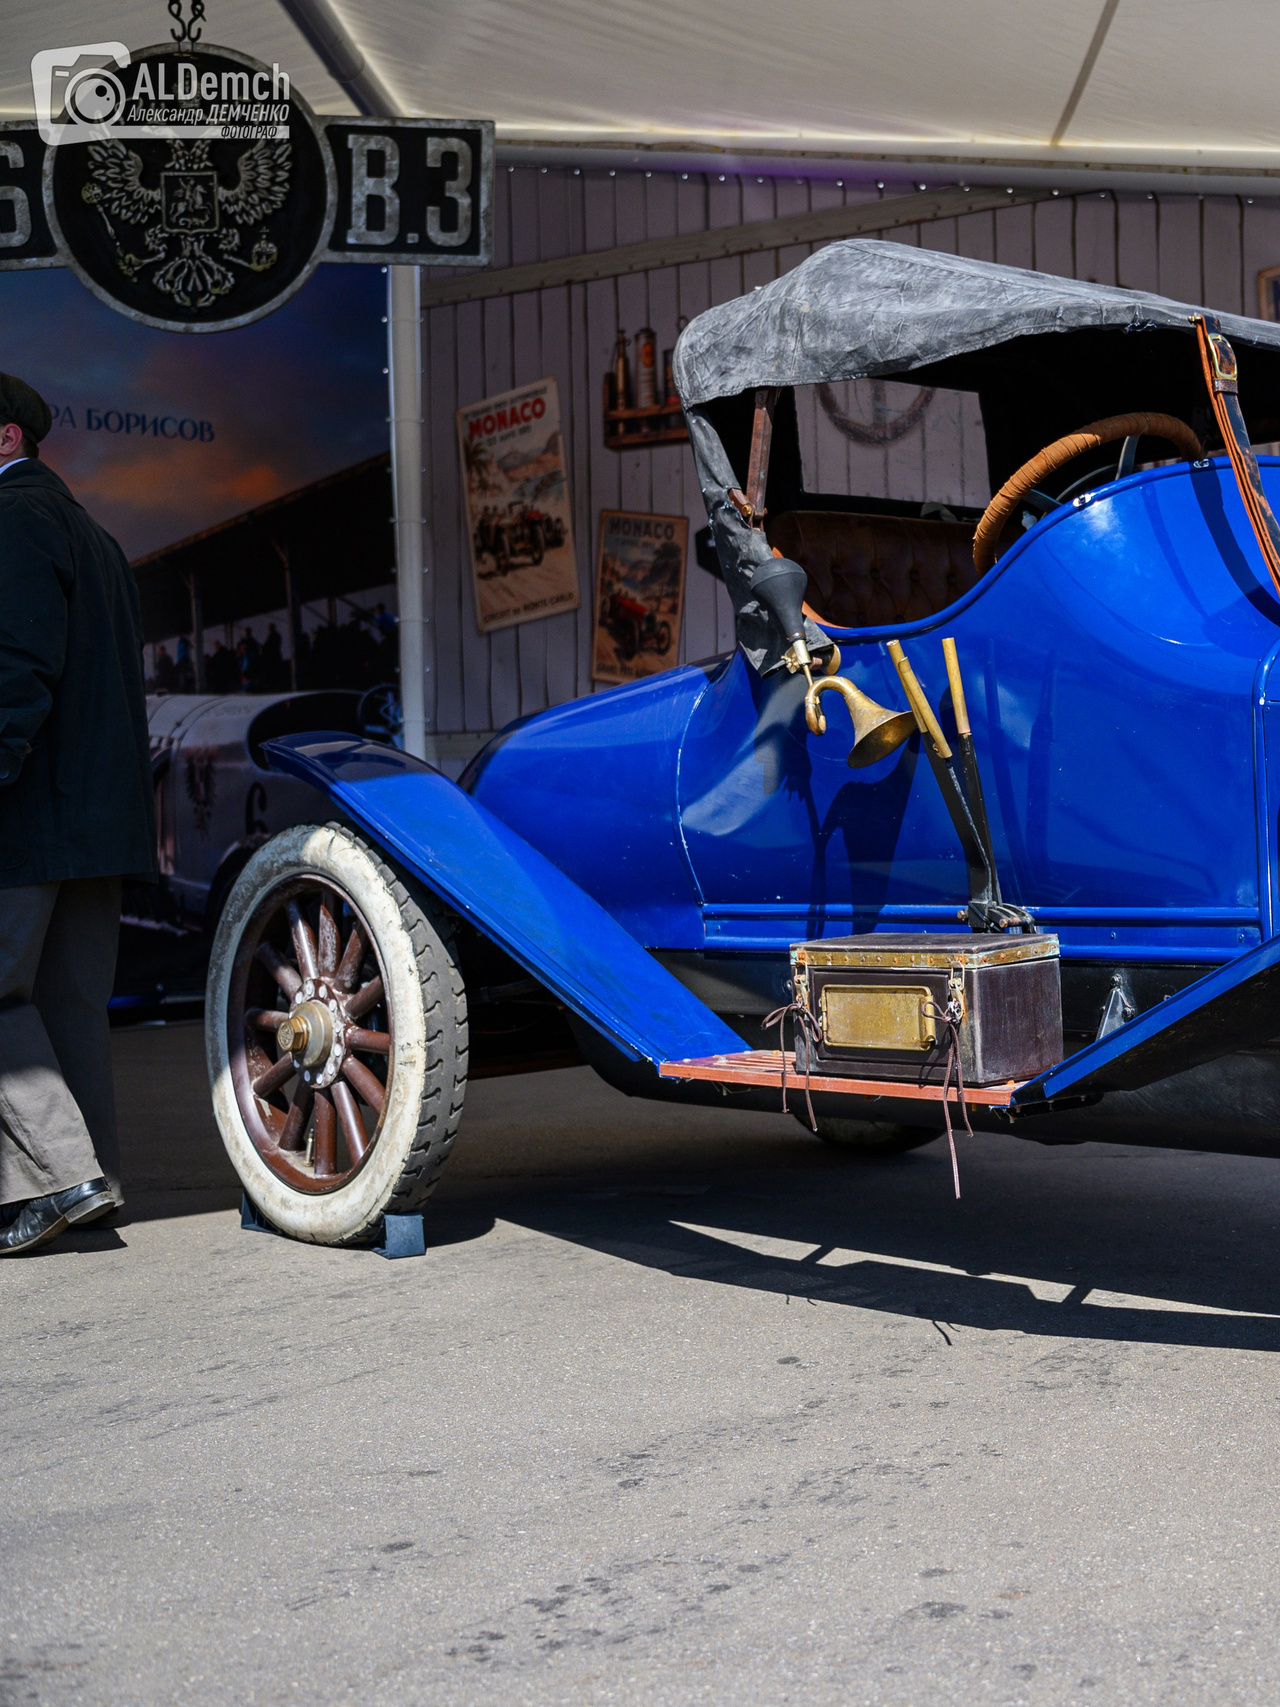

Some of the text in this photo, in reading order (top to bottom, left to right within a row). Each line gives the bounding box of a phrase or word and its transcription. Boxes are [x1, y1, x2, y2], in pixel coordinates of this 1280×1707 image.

[87, 408, 215, 443] БОРИСОВ
[468, 397, 546, 442] MONACO
[609, 517, 675, 541] MONACO
